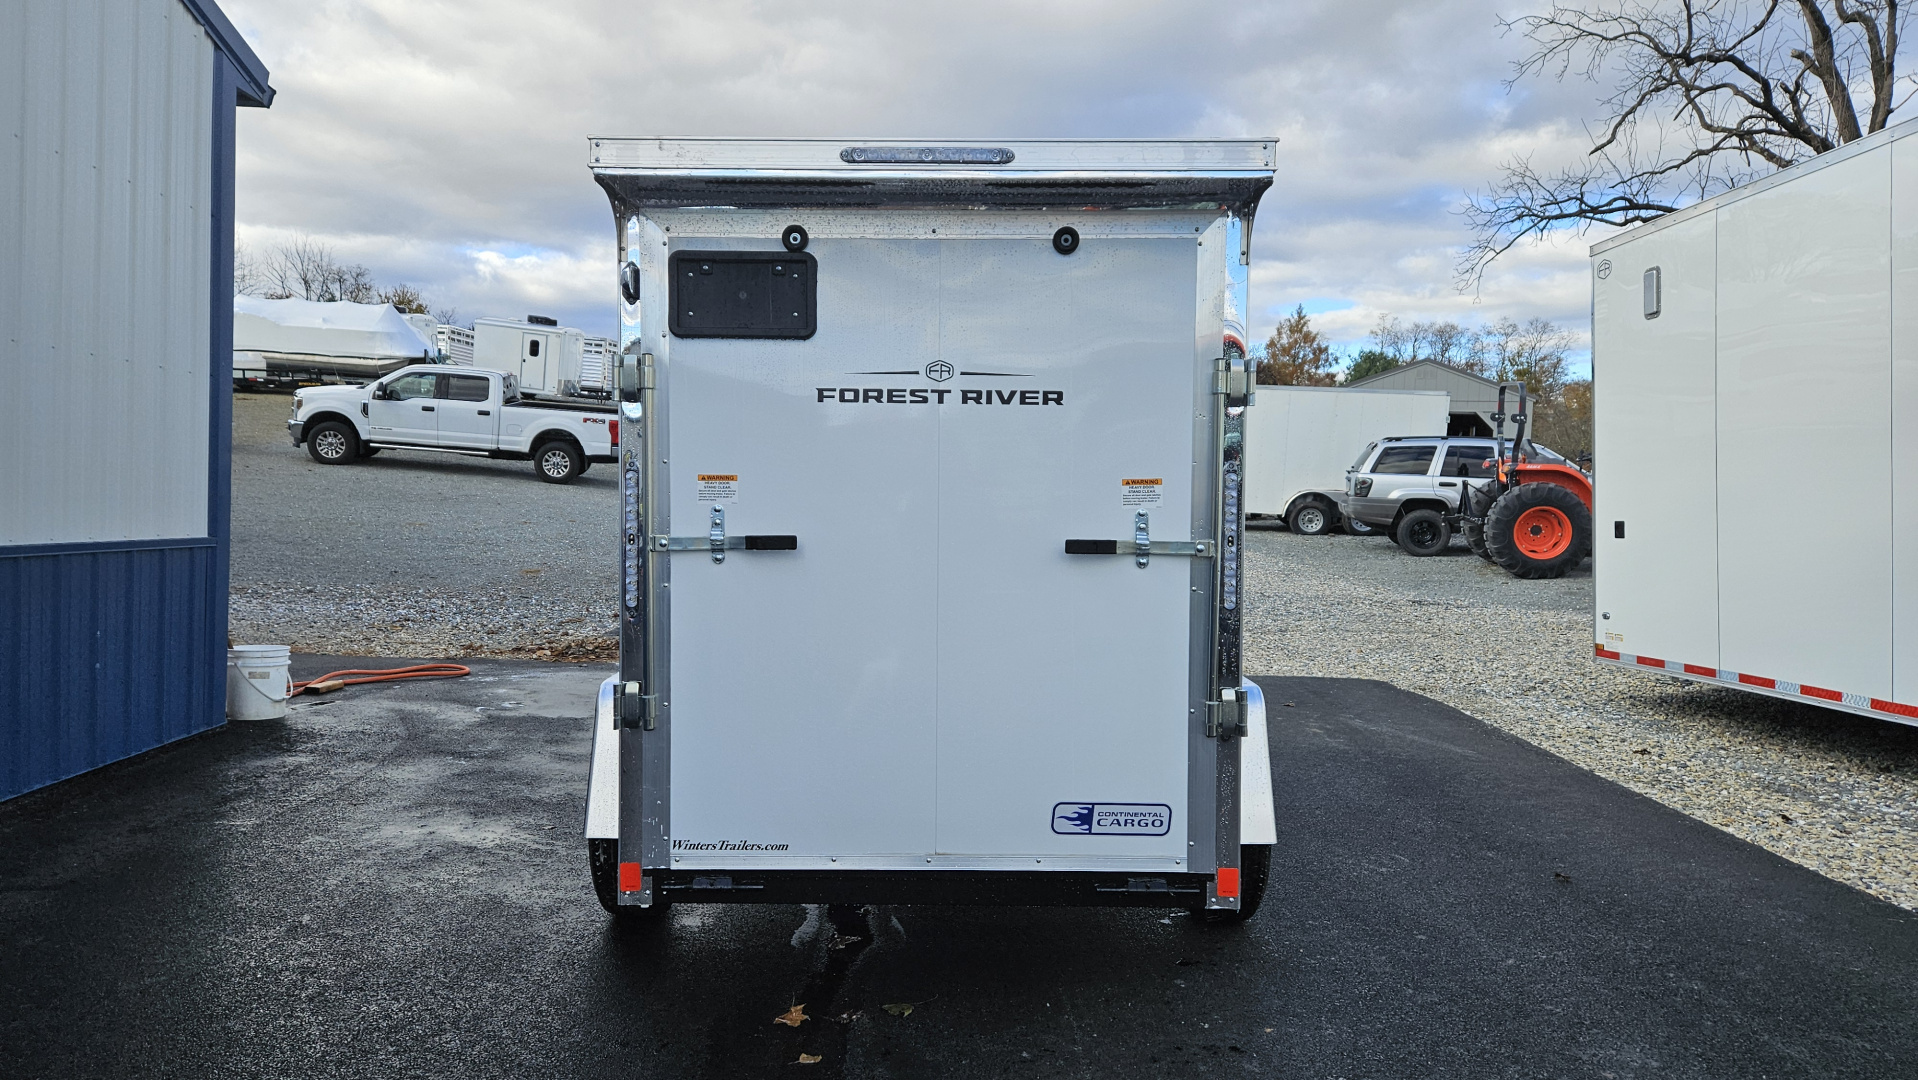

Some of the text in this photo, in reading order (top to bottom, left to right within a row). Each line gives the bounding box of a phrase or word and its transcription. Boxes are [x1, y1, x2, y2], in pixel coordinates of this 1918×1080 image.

[815, 388, 1065, 405] FOREST RIVER
[1096, 818, 1164, 828] CARGO
[672, 839, 789, 851] WintersTrailers.com
